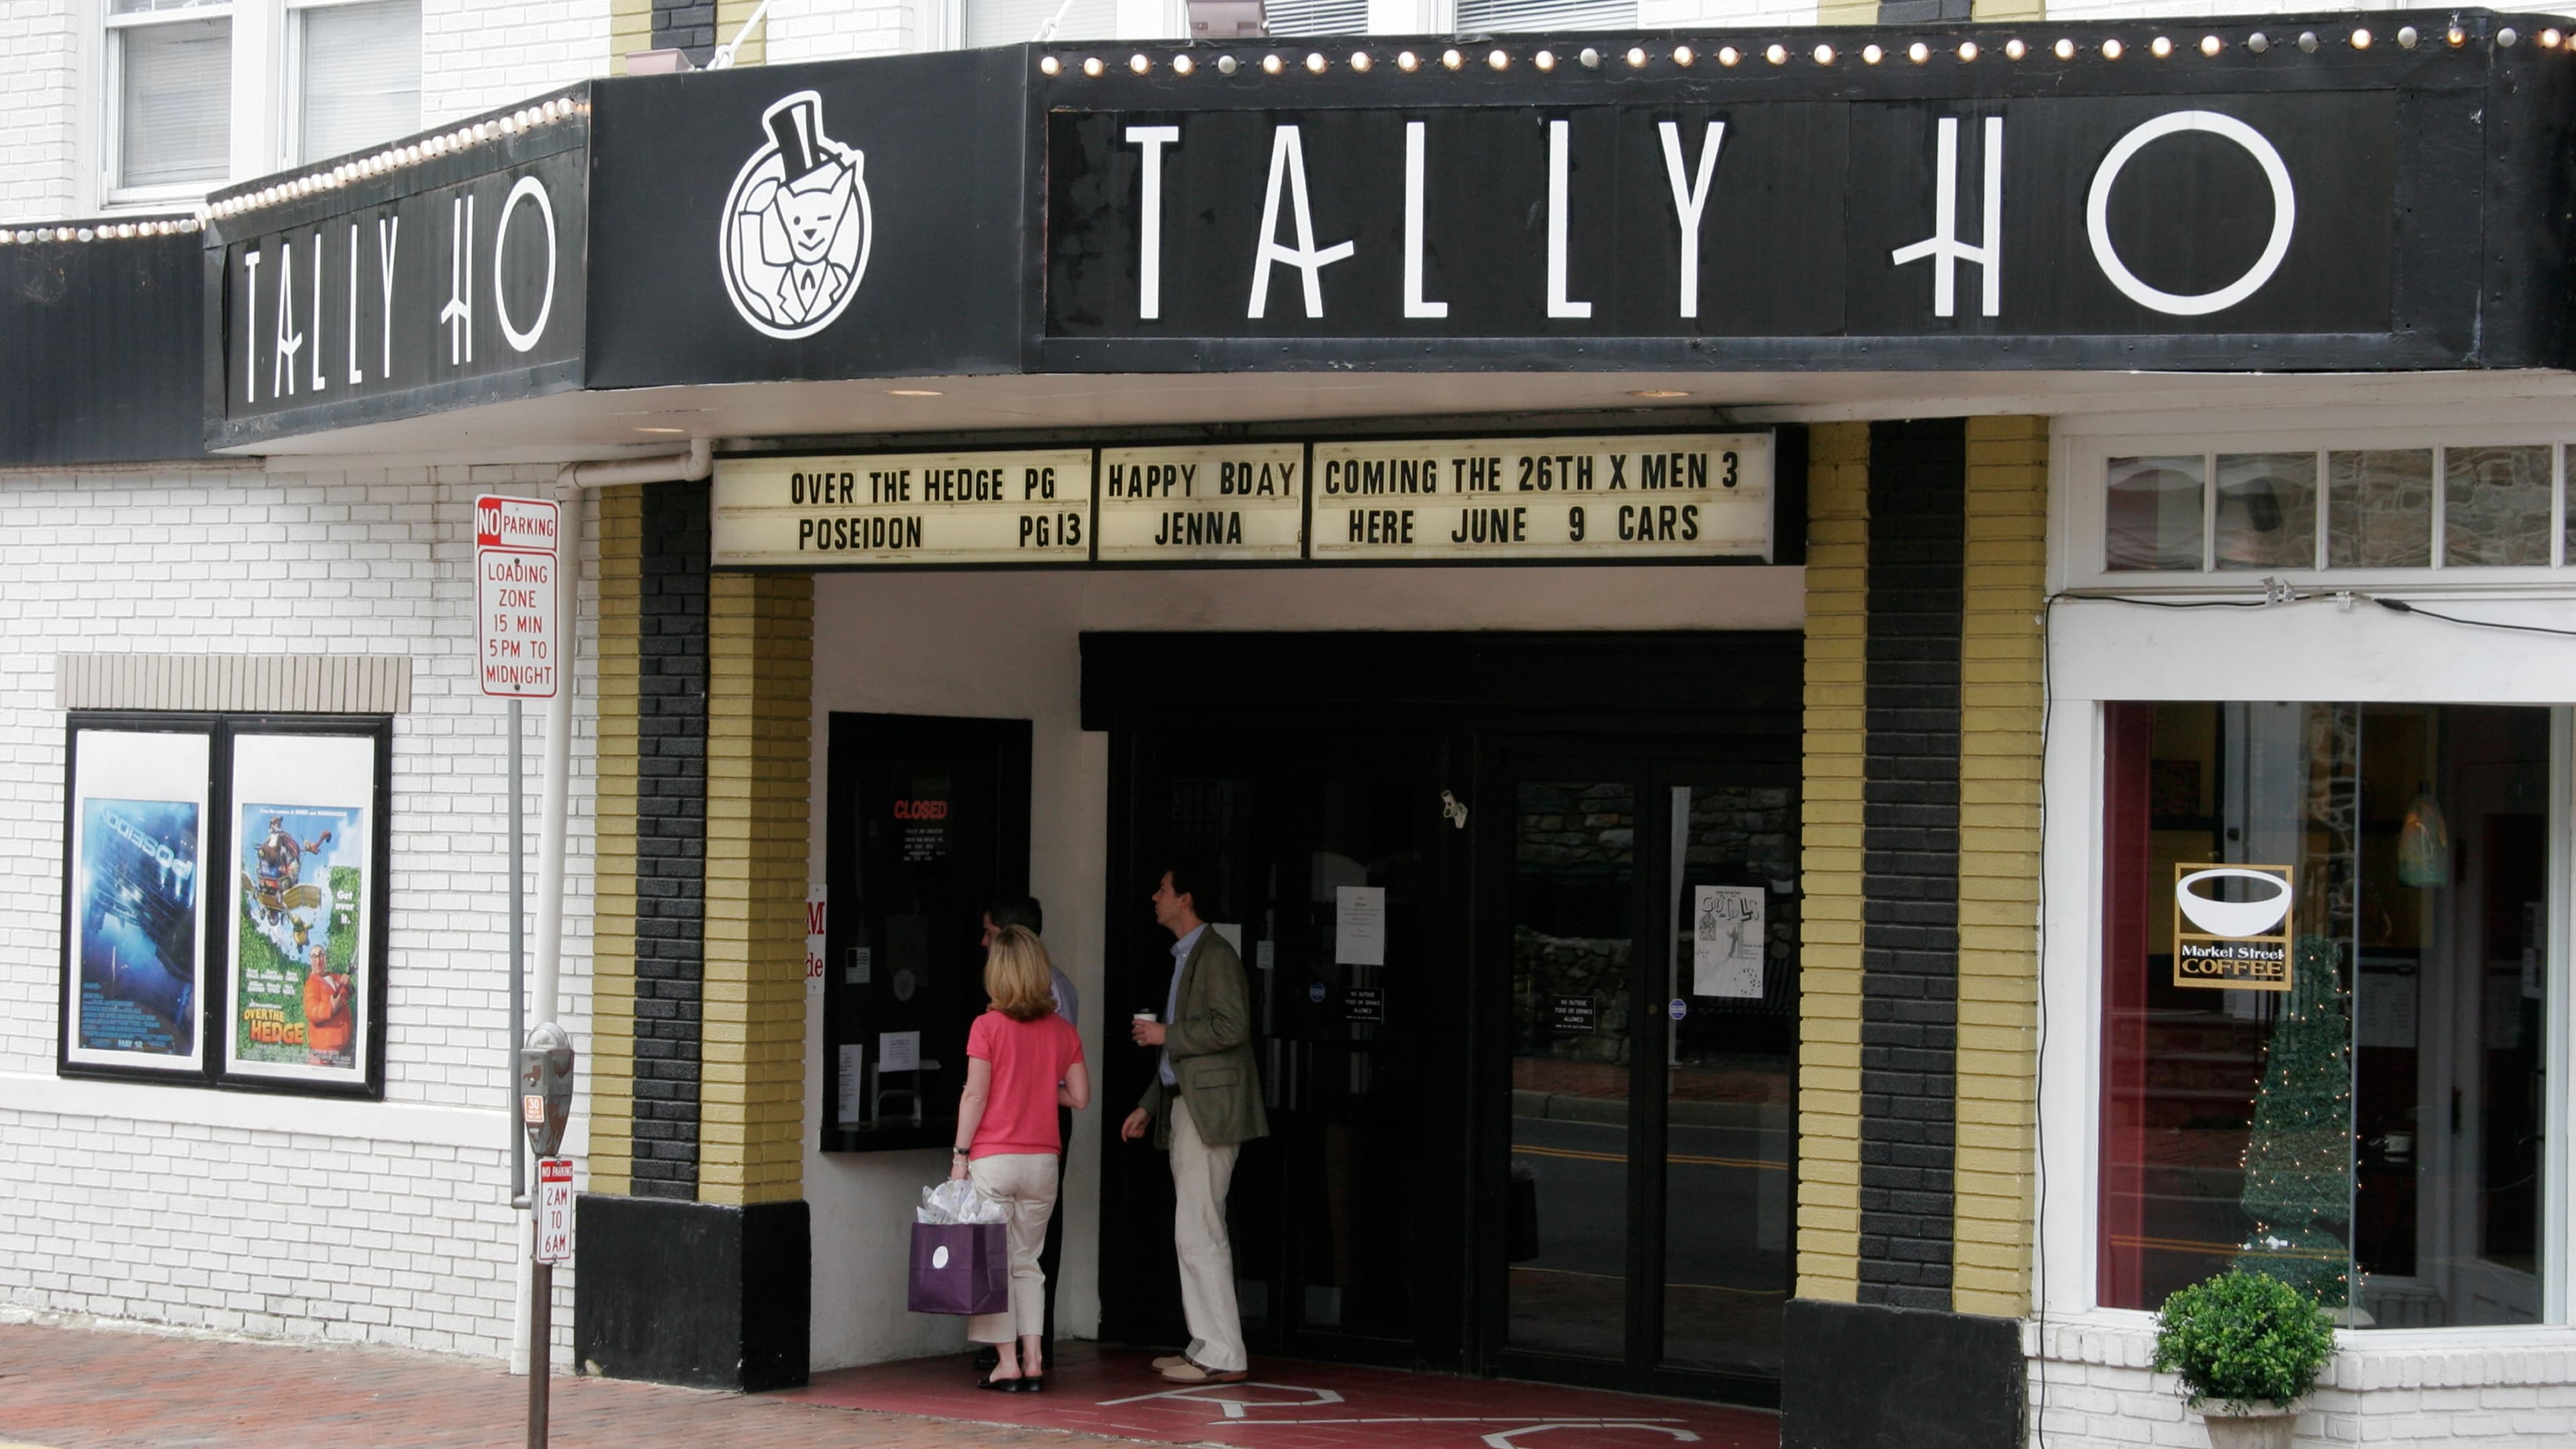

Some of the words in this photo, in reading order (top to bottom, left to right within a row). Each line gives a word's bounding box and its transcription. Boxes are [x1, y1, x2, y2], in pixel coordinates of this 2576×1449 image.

[1126, 120, 1725, 319] TALLY
[1892, 110, 2295, 317] HO
[245, 215, 399, 403] TALLY
[440, 175, 556, 365] HO
[1108, 464, 1197, 498] HAPPY
[1220, 462, 1295, 496] BDAY
[1325, 459, 1438, 495] COMING
[1451, 457, 1501, 494] THE
[1518, 455, 1593, 492] 26TH
[1609, 454, 1628, 490] X
[1640, 452, 1708, 491] MEN
[1722, 450, 1739, 489] 3
[791, 472, 854, 505] OVER
[869, 470, 911, 504] THE
[924, 468, 1003, 502] HEDGE
[1025, 467, 1055, 501] PG
[479, 507, 501, 536] NO
[503, 515, 554, 538] PARKING
[798, 515, 922, 550] POSEIDON
[1154, 511, 1242, 546] JENNA
[1348, 509, 1414, 544] HERE
[1450, 507, 1527, 544] JUNE
[1569, 506, 1585, 543] 9
[1618, 504, 1699, 542] CARS
[488, 562, 548, 584] LOADING
[499, 589, 537, 608] ZONE
[494, 614, 508, 632] 15
[517, 615, 543, 634] MIN
[530, 640, 548, 660] TO
[486, 664, 552, 685] MIDNIGHT
[894, 800, 948, 819] CLOSED
[337, 890, 353, 900] Get
[335, 903, 355, 911] over
[2181, 944, 2234, 958] Market
[2237, 947, 2285, 960] Street
[2181, 958, 2285, 977] COFFEE
[244, 1008, 268, 1021] OVER
[268, 1009, 285, 1023] THE
[250, 1019, 304, 1044] HEDGE
[528, 1097, 540, 1110] 30
[542, 1165, 551, 1177] NO
[546, 1187, 568, 1206] 2AM
[551, 1210, 562, 1230] TO
[544, 1234, 566, 1254] 6AM
